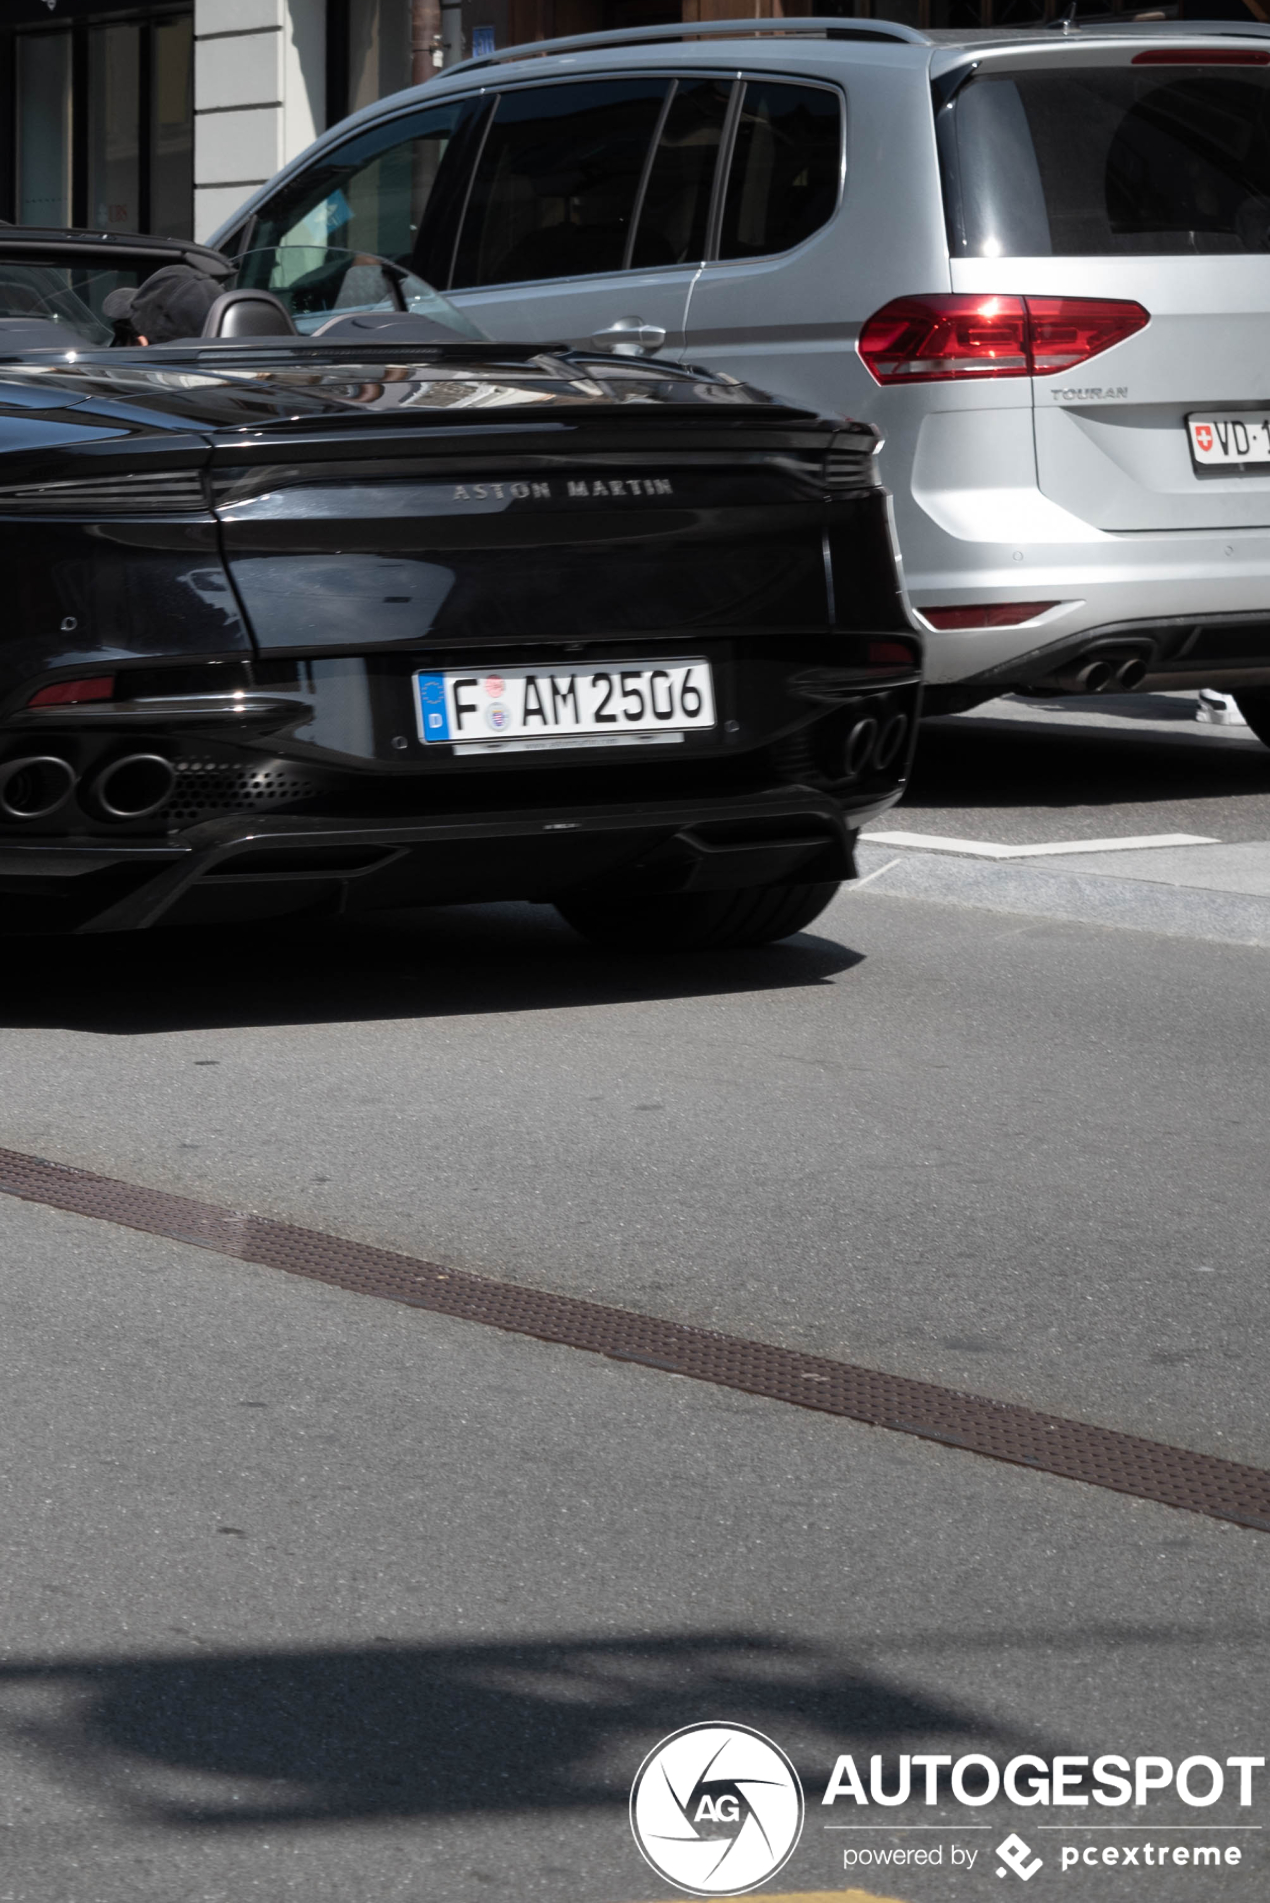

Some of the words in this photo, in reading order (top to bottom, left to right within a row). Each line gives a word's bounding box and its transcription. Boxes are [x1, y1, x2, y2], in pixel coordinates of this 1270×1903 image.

[1050, 387, 1128, 401] TOURAN
[452, 482, 551, 501] ASTON
[567, 479, 673, 497] MARTIN
[452, 679, 478, 731] F
[428, 713, 443, 728] D
